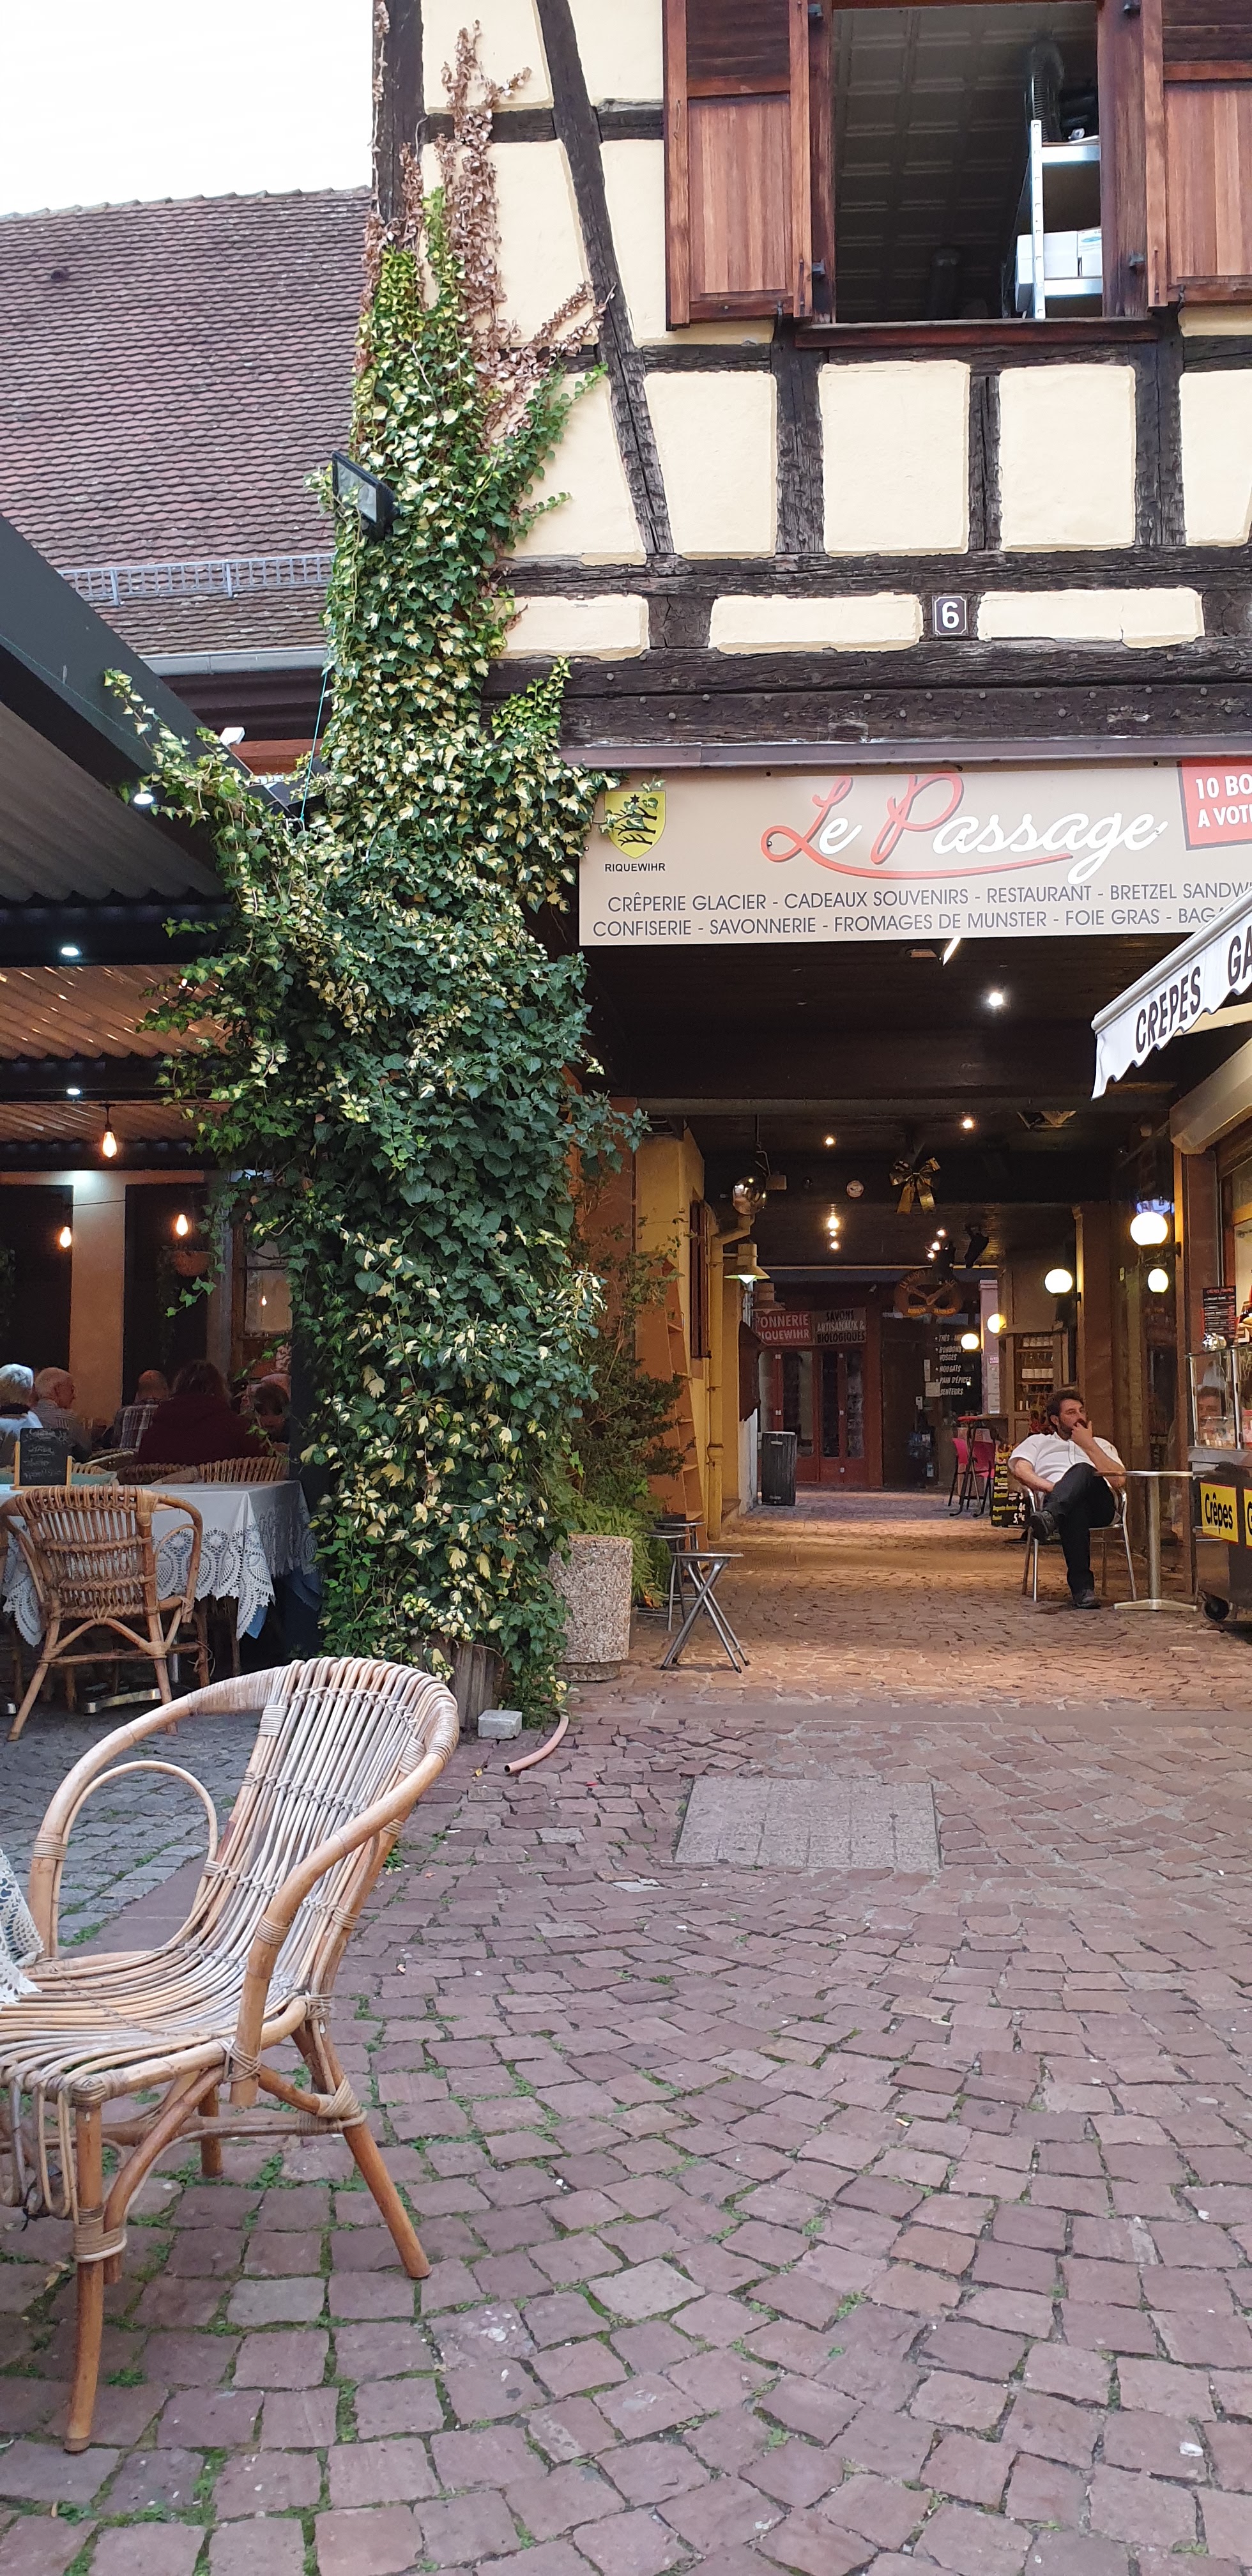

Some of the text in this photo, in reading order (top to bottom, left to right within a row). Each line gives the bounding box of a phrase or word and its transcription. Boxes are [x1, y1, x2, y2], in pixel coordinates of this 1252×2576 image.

[942, 601, 959, 629] 6
[1195, 777, 1219, 799] 10
[761, 770, 1168, 885] Le Passage
[1198, 808, 1211, 828] A
[605, 862, 666, 872] RIQUEWIHR
[608, 892, 686, 912] CRÊPERIE
[692, 894, 767, 910] GLACIER
[784, 891, 868, 909] CADEAUX
[873, 888, 968, 907] SOUVENIRS
[987, 885, 1092, 903] RESTAURANT
[1110, 884, 1177, 900] BRETZEL
[1183, 882, 1252, 899] SANDW
[593, 920, 692, 937] CONFISERIE
[710, 917, 816, 935] SAVONNERIE
[834, 914, 933, 932] FROMAGES
[939, 913, 961, 929] DE
[968, 910, 1047, 928] MUNSTER
[1065, 910, 1104, 926] FOIE
[1111, 908, 1160, 925] GRAS
[1179, 907, 1224, 923] BAG
[1136, 966, 1201, 1053] CREPES
[817, 1331, 865, 1344] BIOLOGIQUES
[1205, 1492, 1233, 1535] Crêpes
